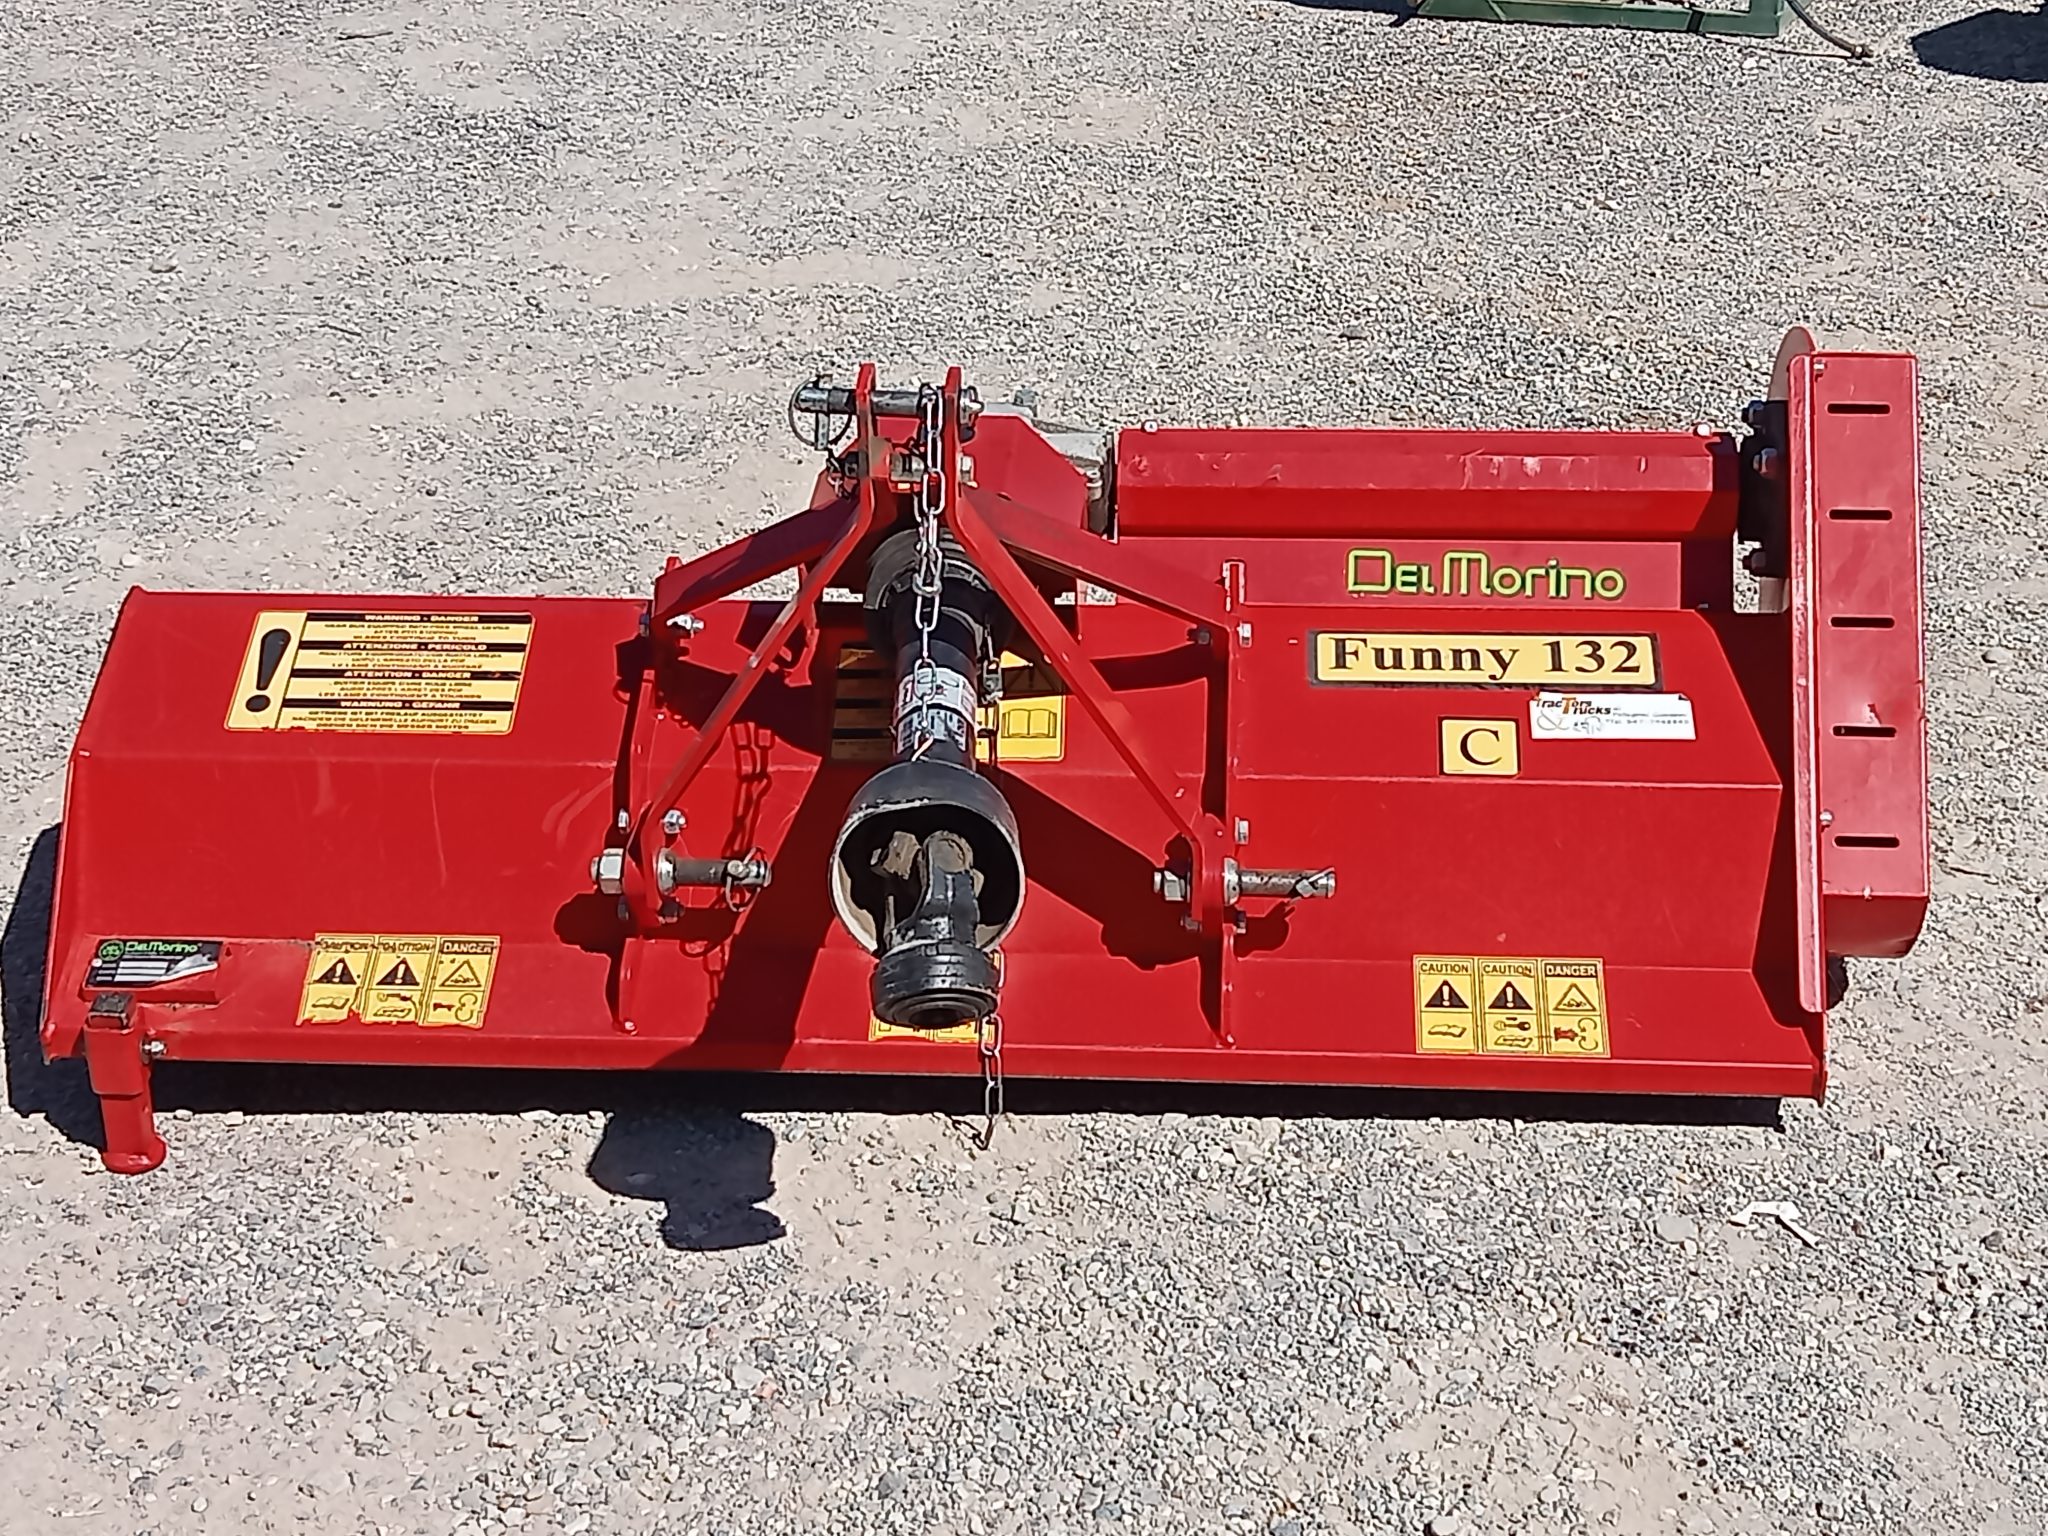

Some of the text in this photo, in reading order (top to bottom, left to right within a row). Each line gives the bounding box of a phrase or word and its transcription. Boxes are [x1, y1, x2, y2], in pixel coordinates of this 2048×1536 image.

[430, 615, 479, 623] DANGER
[428, 643, 487, 651] PERICOLO
[1329, 637, 1641, 681] Funny 132
[422, 671, 472, 679] DANGER
[1460, 728, 1502, 766] C
[443, 942, 493, 953] DANGER
[1420, 963, 1469, 973] CAUTION
[1483, 964, 1532, 974] CAUTION
[1546, 965, 1597, 976] DANGER
